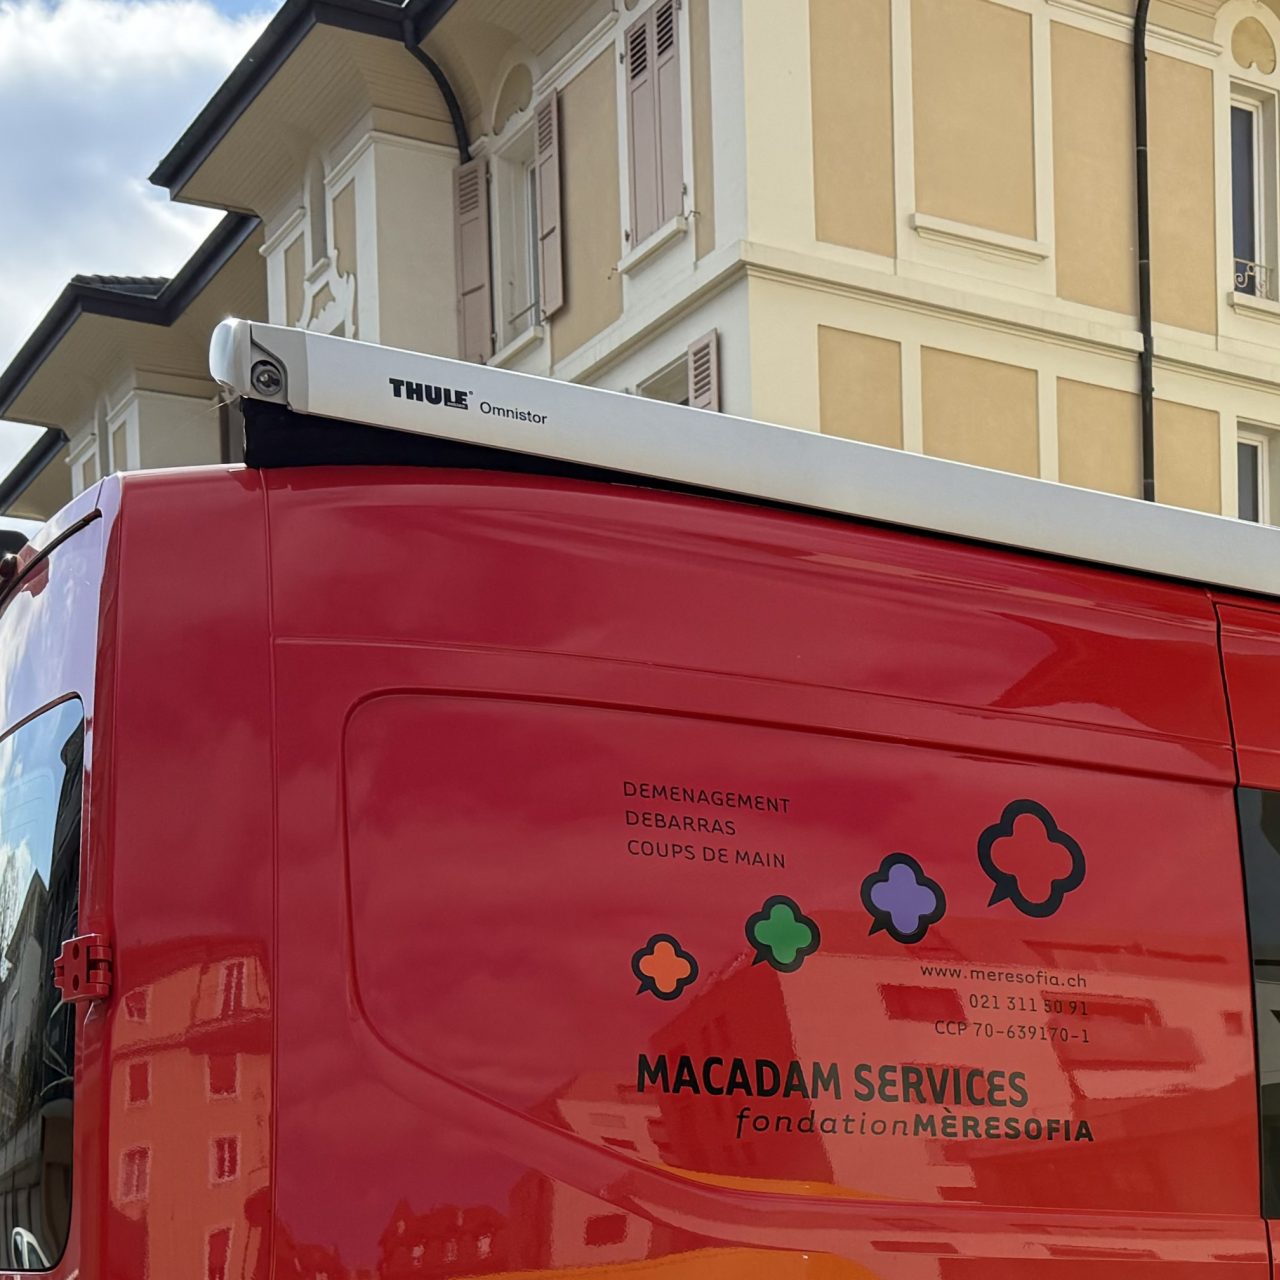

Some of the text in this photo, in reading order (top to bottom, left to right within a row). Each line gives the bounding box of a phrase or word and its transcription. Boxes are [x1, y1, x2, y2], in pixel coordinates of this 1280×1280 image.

[389, 377, 548, 425] THULE Omnistor
[623, 781, 790, 813] DEMENAGEMENT
[625, 810, 736, 836] DEBARRAS
[627, 839, 785, 869] COUPS DE MAIN
[920, 965, 1087, 988] www.meresofia.ch
[969, 993, 1089, 1016] 021 311 50 91
[935, 1020, 1090, 1043] CCP 70-639170-1
[636, 1053, 1029, 1108] MACADAM SERVICES
